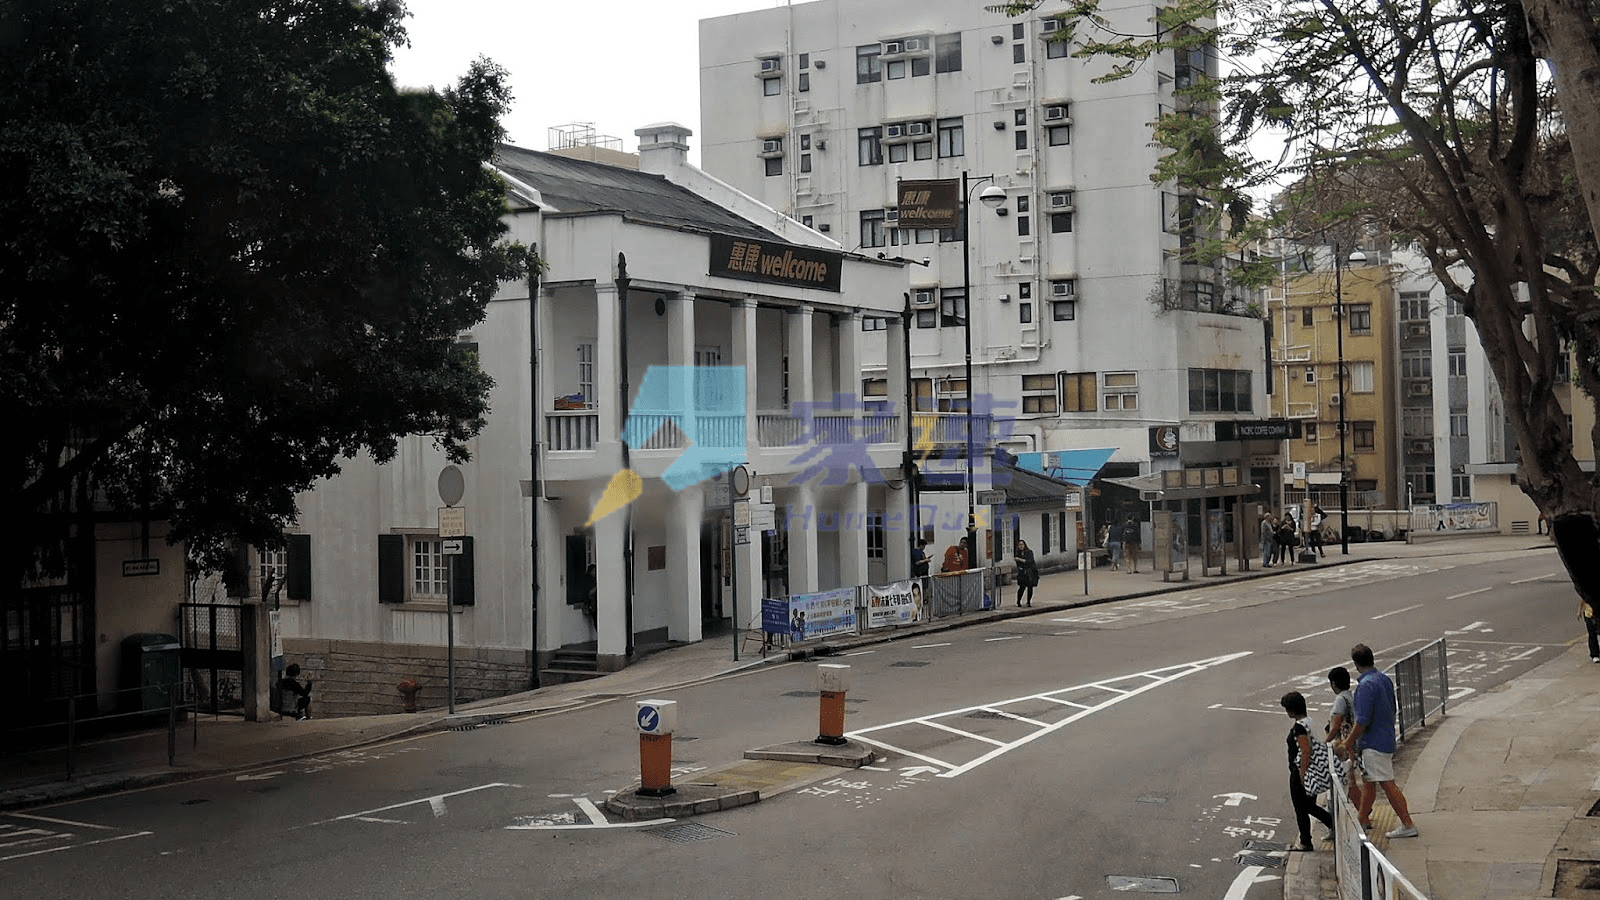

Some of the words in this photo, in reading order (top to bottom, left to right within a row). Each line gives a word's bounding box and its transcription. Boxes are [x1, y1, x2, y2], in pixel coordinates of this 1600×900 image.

[900, 207, 953, 219] wellcome
[728, 241, 761, 272] 惠康
[761, 250, 827, 282] wellcome
